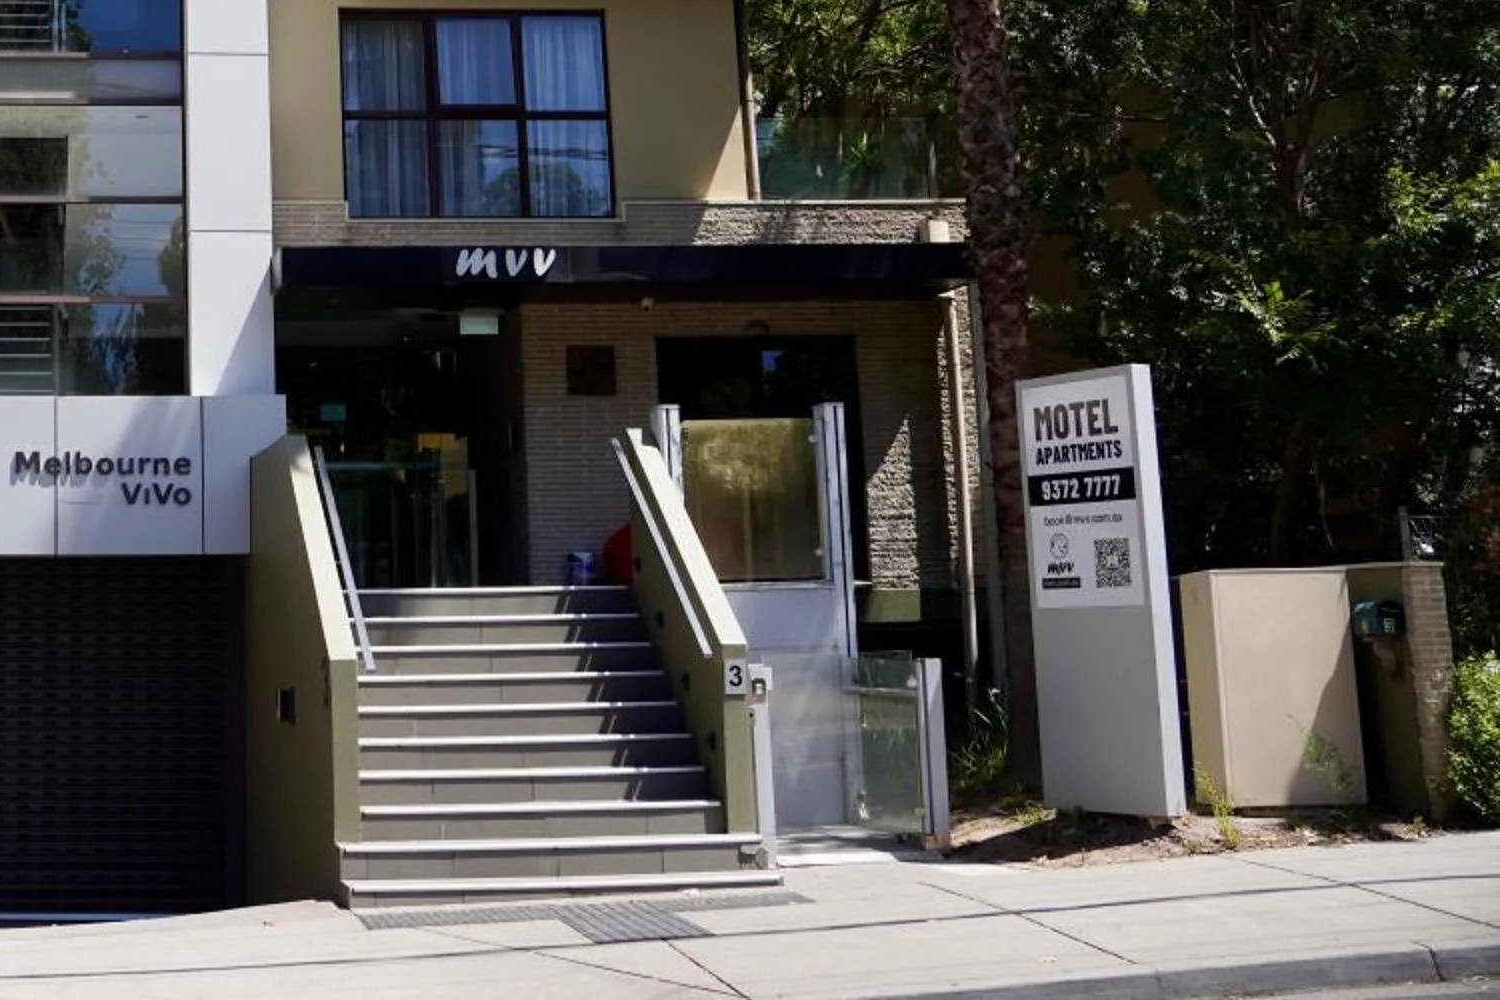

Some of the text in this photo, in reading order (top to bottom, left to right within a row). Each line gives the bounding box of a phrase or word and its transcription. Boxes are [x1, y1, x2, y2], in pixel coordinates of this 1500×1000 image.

[1033, 399, 1119, 441] MOTEL
[13, 451, 192, 476] Melbourne
[1036, 440, 1122, 465] APARTMENTS
[1041, 475, 1121, 500] 9372 7777
[729, 664, 743, 687] 3
